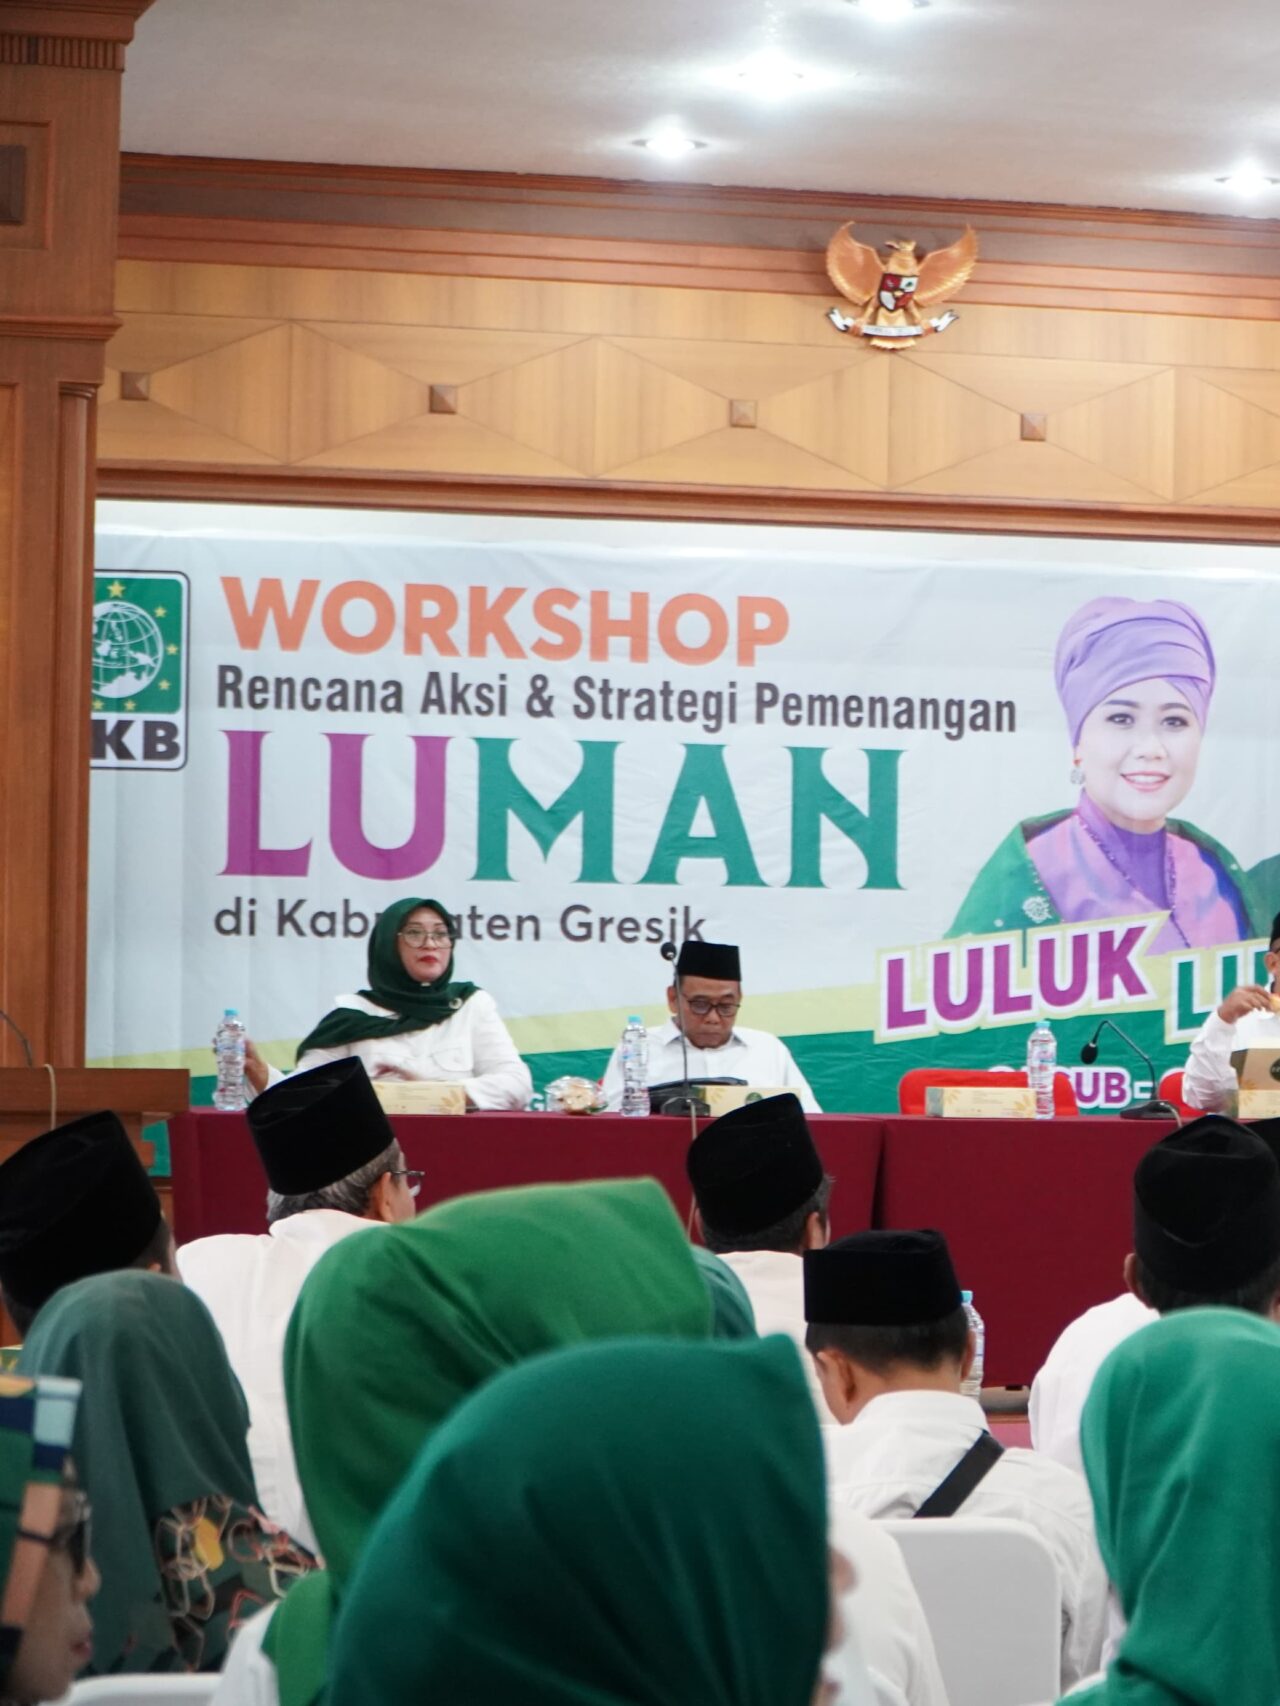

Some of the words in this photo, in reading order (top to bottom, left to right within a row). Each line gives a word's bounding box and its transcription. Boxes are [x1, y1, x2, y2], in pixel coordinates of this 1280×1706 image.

[220, 576, 790, 666] WORKSHOP
[91, 719, 181, 761] KB
[217, 664, 404, 714] Rencana
[420, 670, 508, 717] Aksi
[525, 673, 555, 718] &
[573, 674, 738, 734] Strategi
[755, 682, 1017, 741] Pemenangan
[216, 729, 909, 891] LUMAN
[213, 896, 257, 937] di
[559, 905, 706, 944] Gresik
[887, 926, 1147, 1030] LULUK
